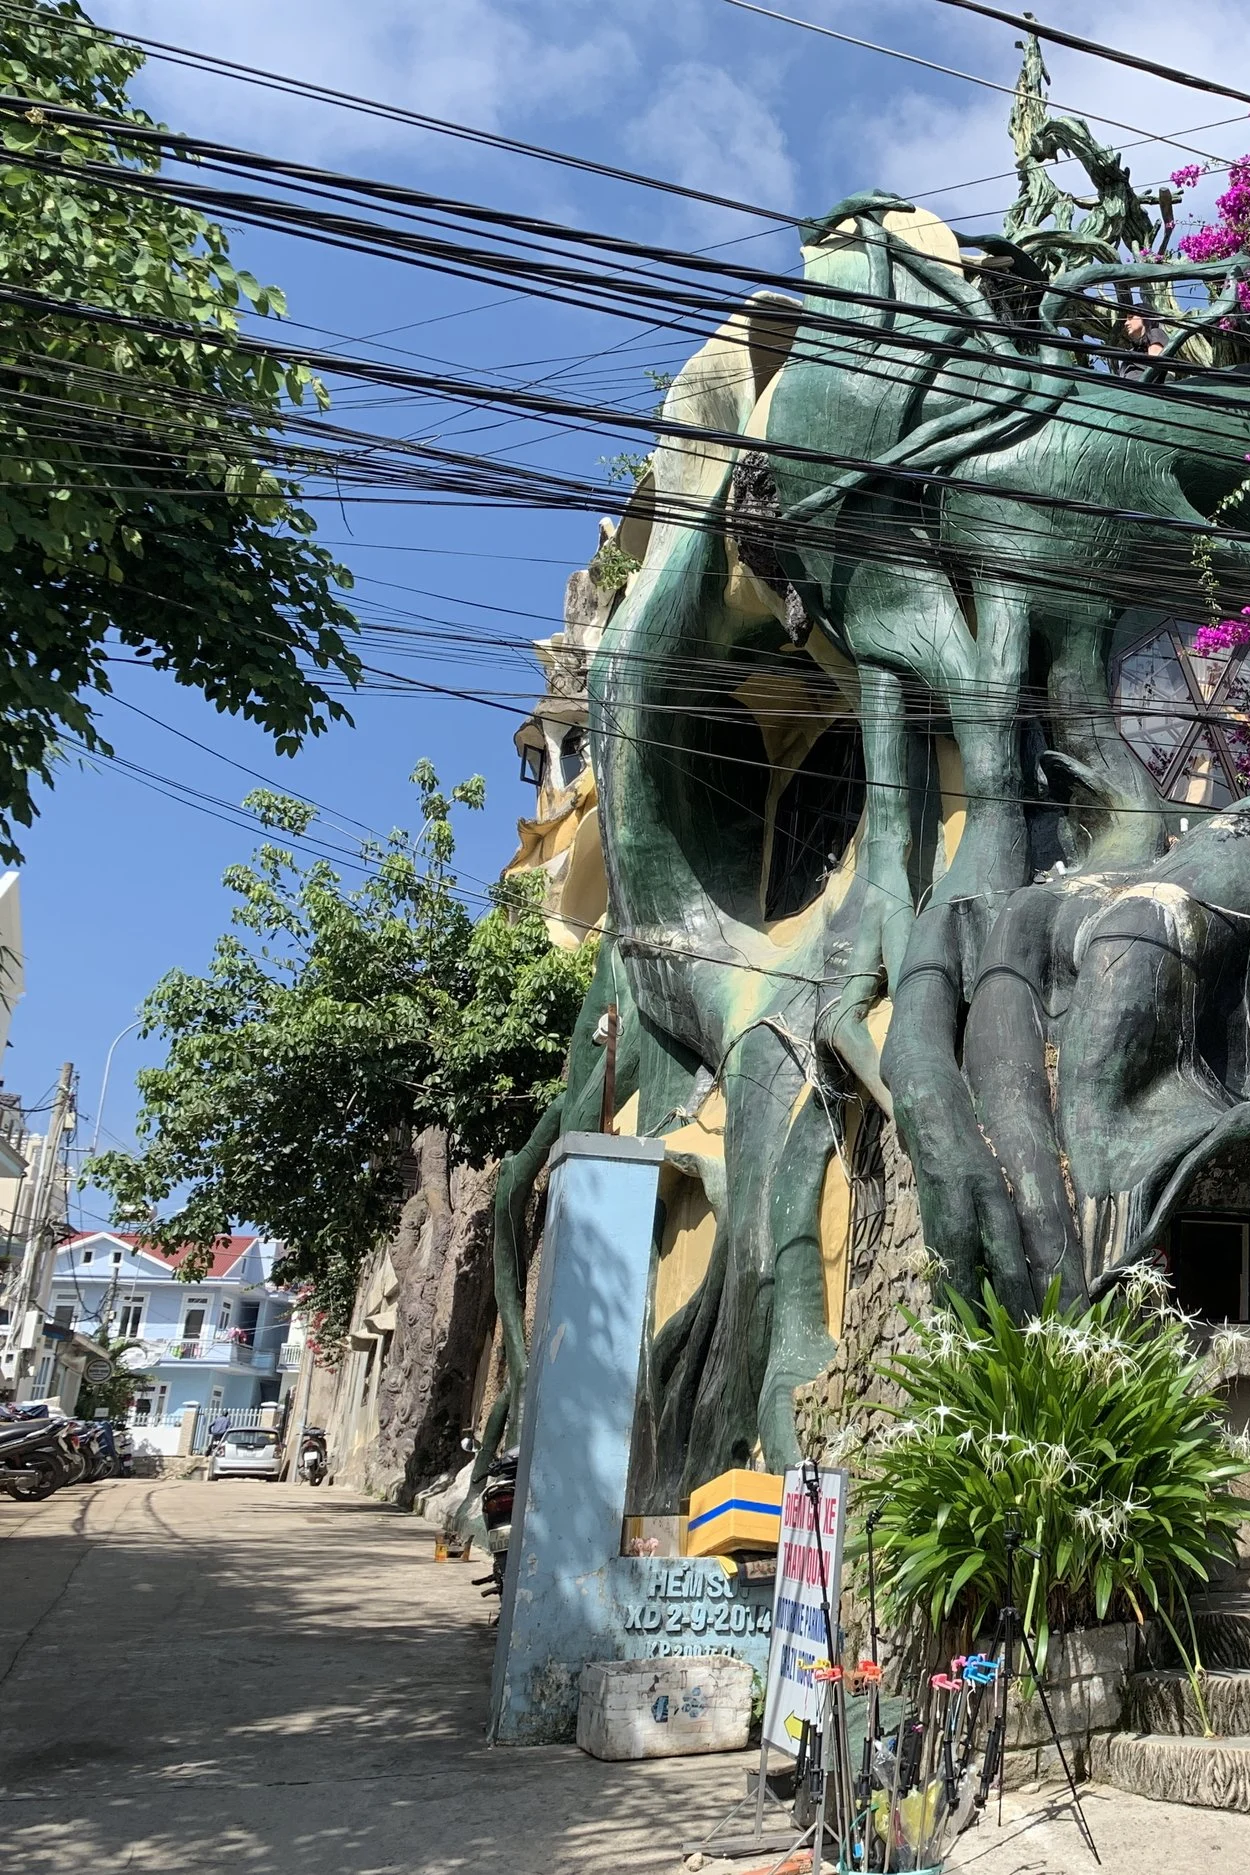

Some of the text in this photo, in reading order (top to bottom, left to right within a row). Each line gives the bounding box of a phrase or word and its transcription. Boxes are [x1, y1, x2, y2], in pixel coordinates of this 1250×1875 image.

[823, 1498, 837, 1535] XE
[625, 1603, 772, 1633] XD 2-9-2014
